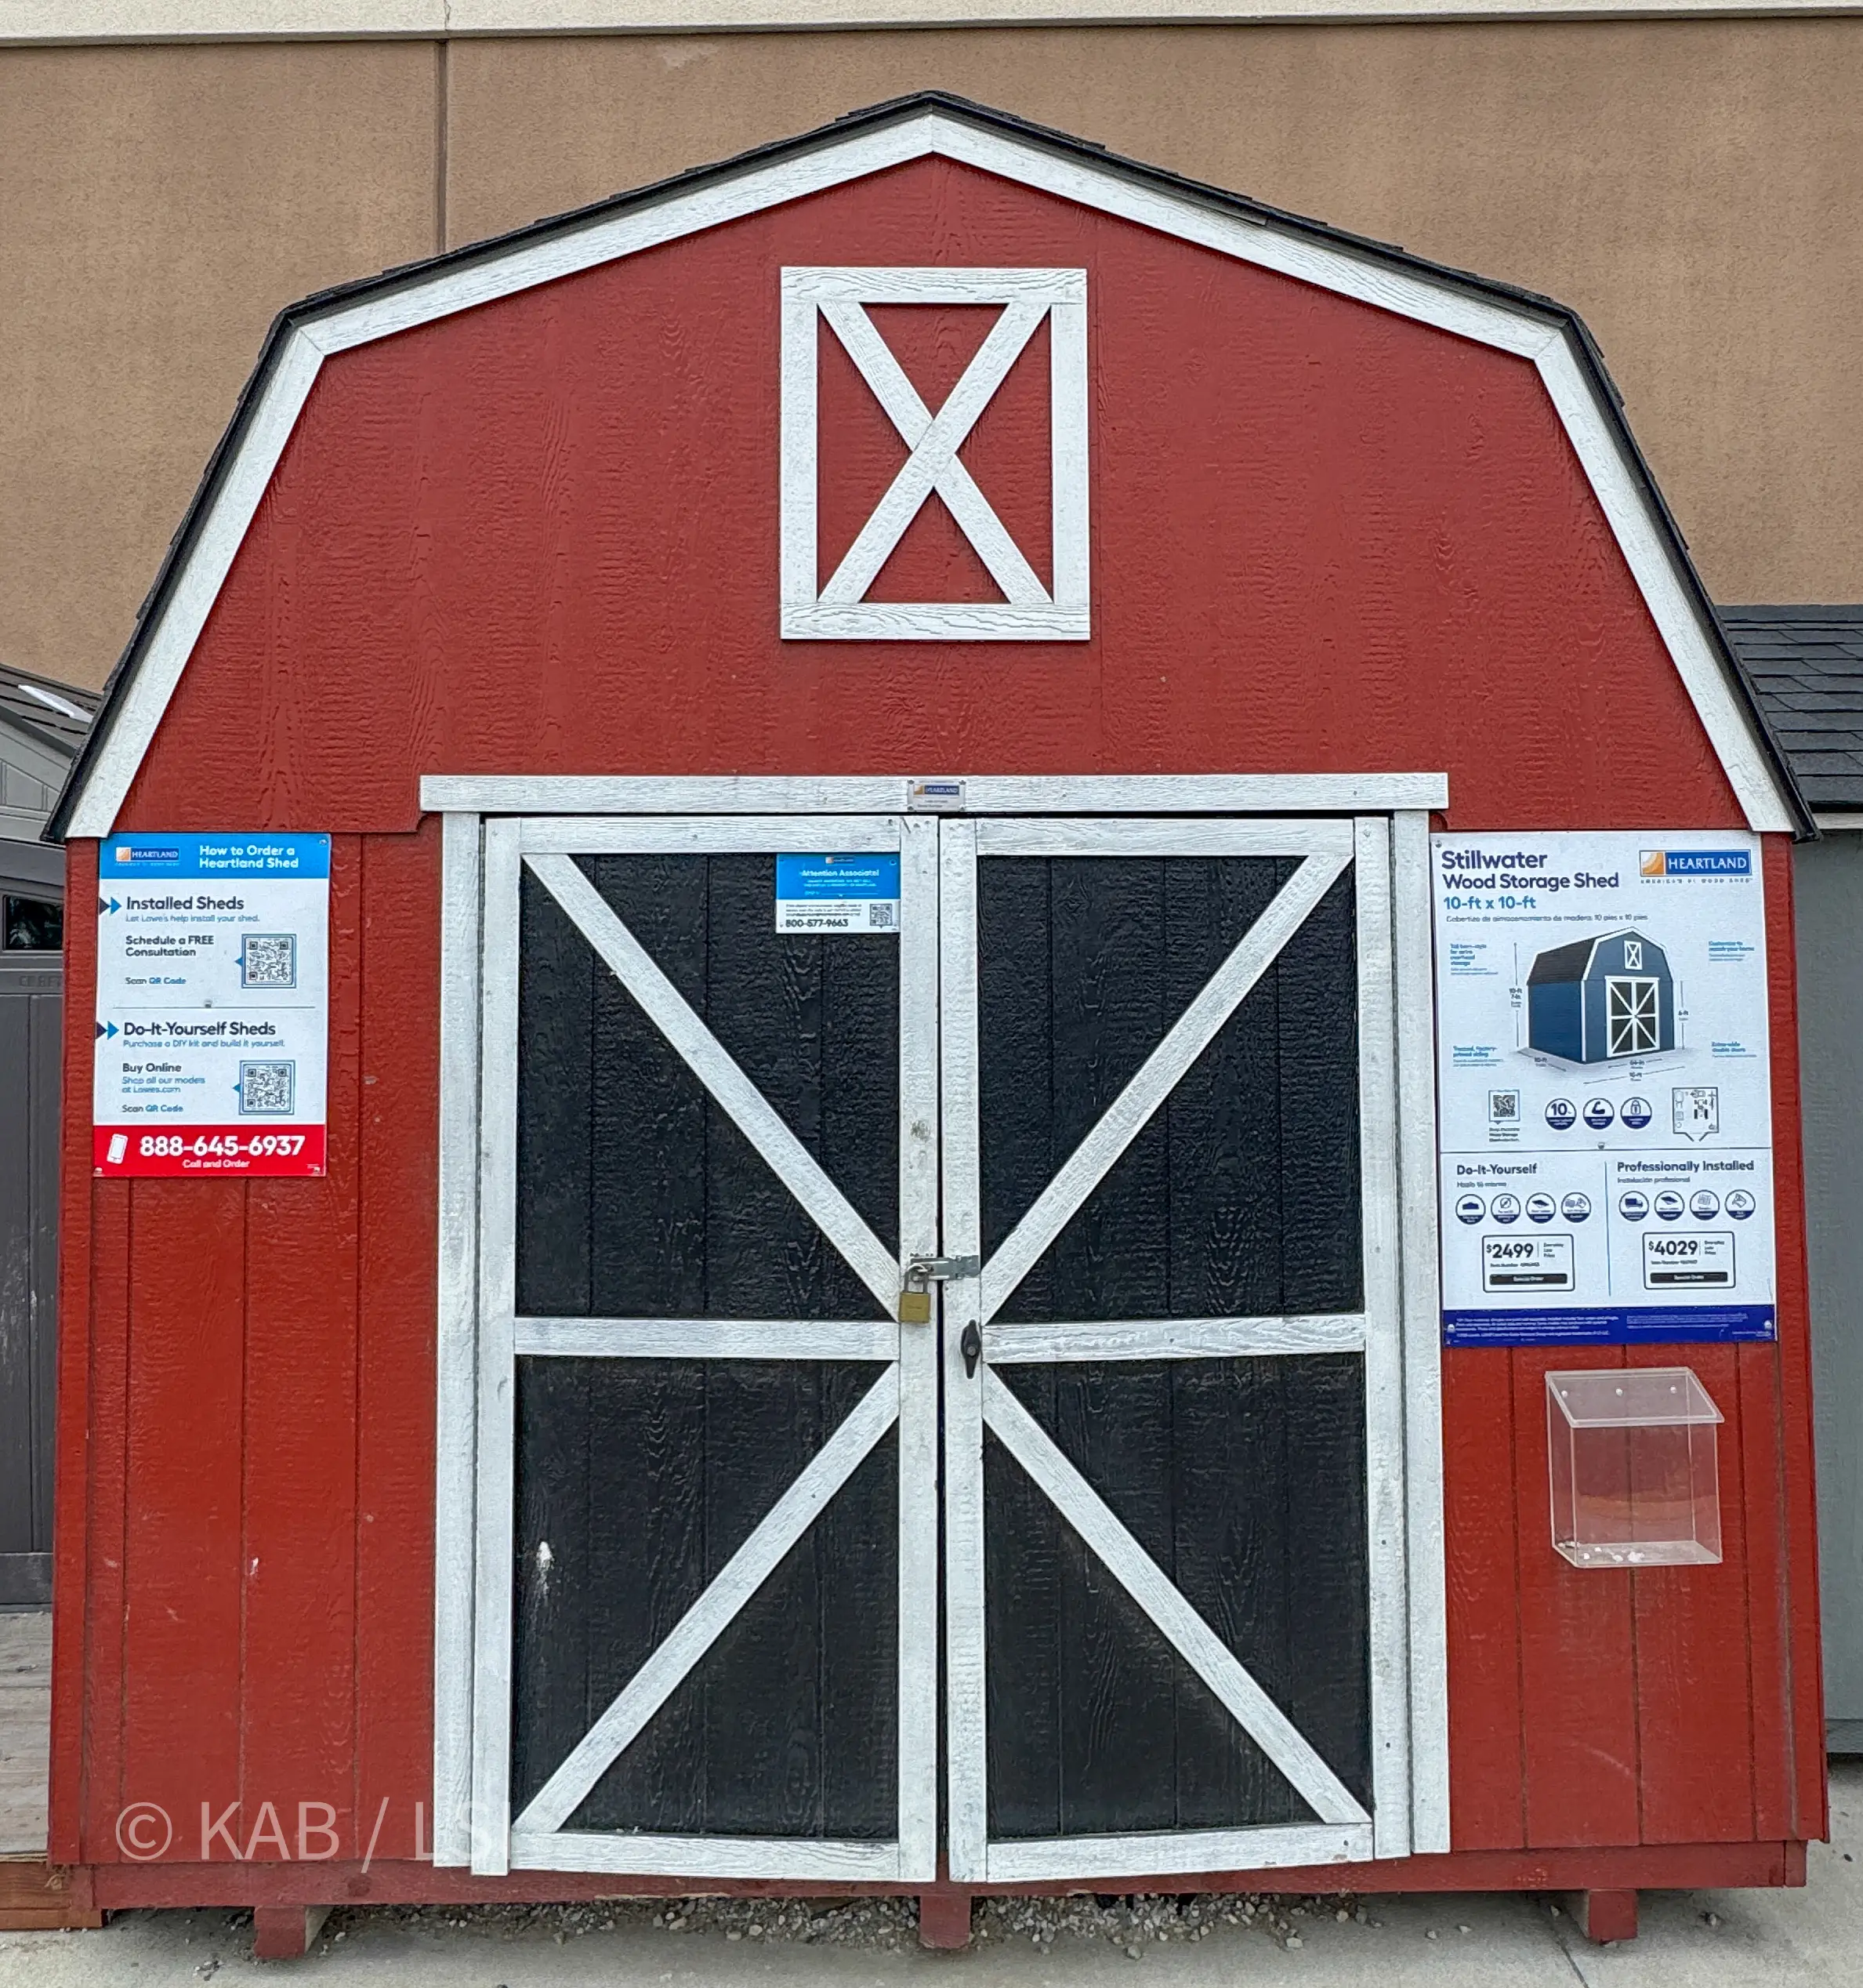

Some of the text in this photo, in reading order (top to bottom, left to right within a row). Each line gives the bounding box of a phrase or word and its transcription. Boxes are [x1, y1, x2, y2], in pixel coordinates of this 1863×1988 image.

[200, 845, 227, 855] How
[230, 847, 244, 855] to
[247, 845, 284, 855] Order
[199, 858, 299, 868] Heartland Shed
[1441, 850, 1547, 869] Stillwater
[1669, 857, 1747, 869] HEARTLAND
[1442, 872, 1619, 892] Wood Storage Shed
[127, 896, 245, 909] Installed Sheds
[1444, 895, 1536, 909] 10-ft x 10-ft
[170, 915, 188, 923] help
[785, 919, 849, 927] 800-577-9663
[125, 936, 176, 945] Schedule
[188, 935, 214, 945] FREE
[125, 948, 196, 956] Consultation
[124, 1021, 276, 1036] Do-It-Yourself Sheds
[122, 1062, 182, 1073] Buy Online
[1551, 1103, 1568, 1116] 10
[140, 1136, 305, 1156] 888-645-6937
[182, 1159, 250, 1168] Call and Order
[1457, 1163, 1538, 1175] Do-It-Yourself
[1618, 1160, 1754, 1173] Professionally Installed
[1486, 1242, 1534, 1258] $2499
[1648, 1240, 1698, 1255] $4029
